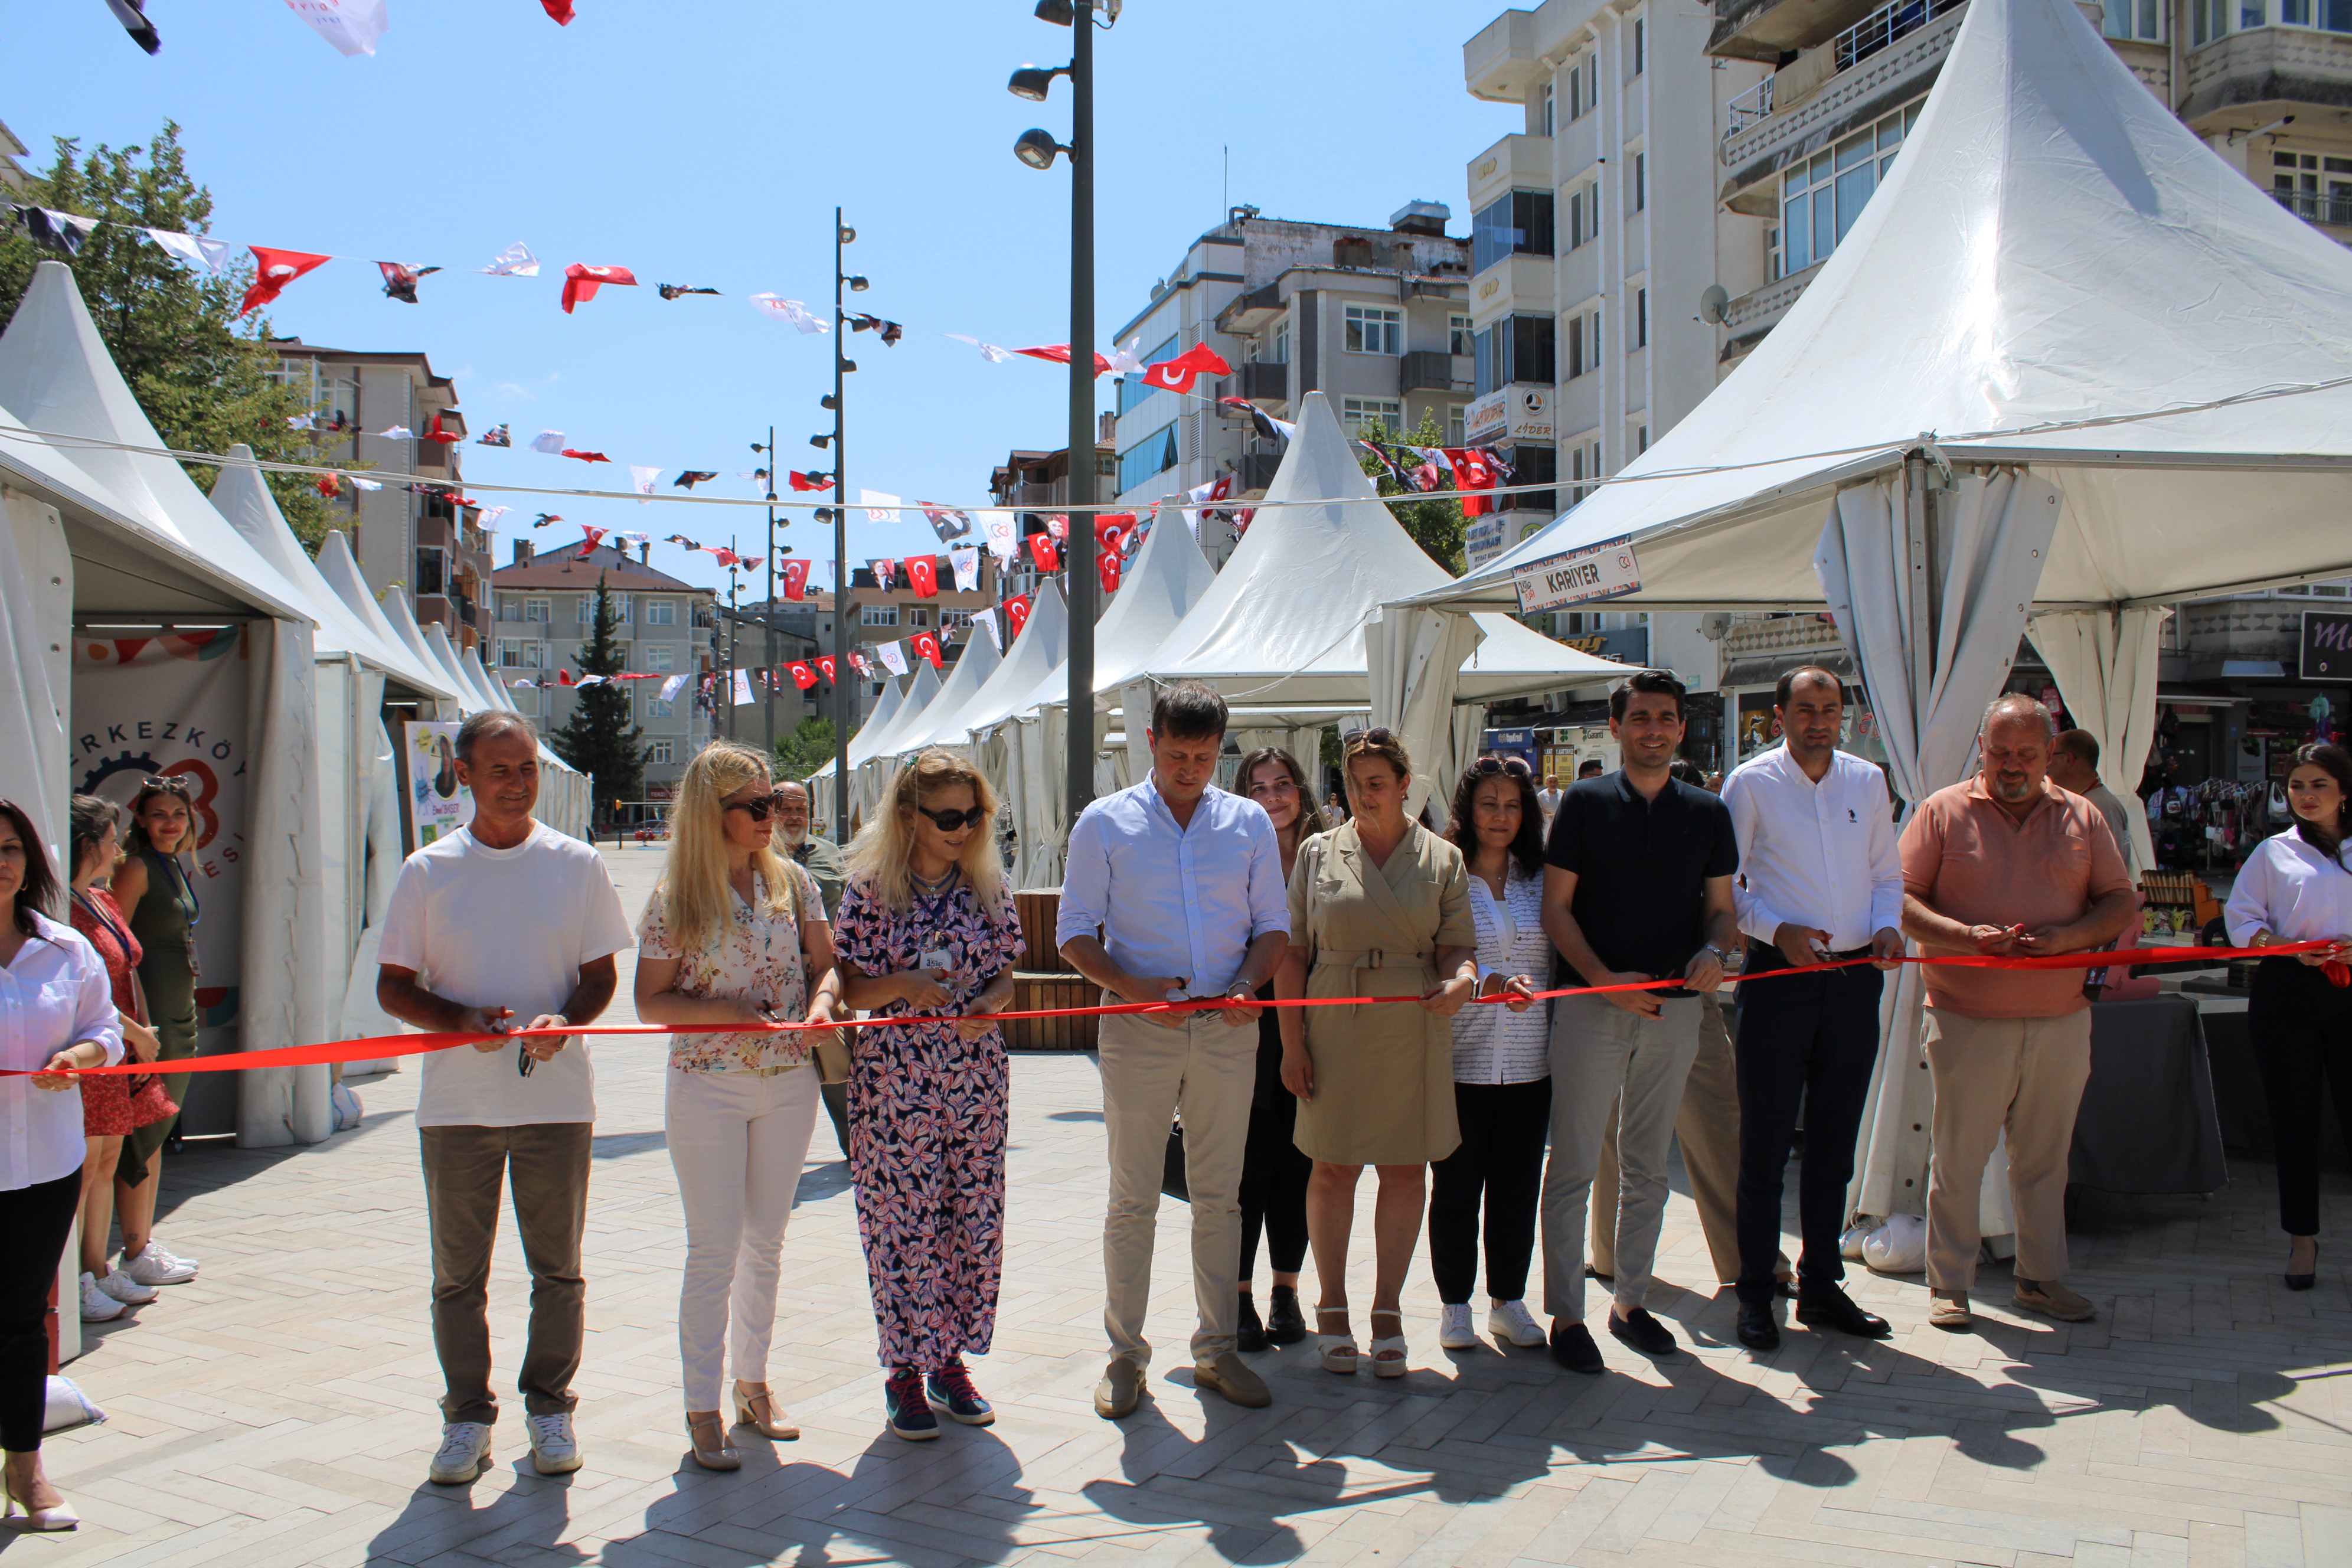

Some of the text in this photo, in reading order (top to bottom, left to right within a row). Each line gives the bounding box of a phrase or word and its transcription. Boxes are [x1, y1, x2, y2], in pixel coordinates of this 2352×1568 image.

[1514, 422, 1551, 435] LİDER
[1546, 563, 1600, 593] KARİYER
[1587, 730, 1603, 739] Garanti
